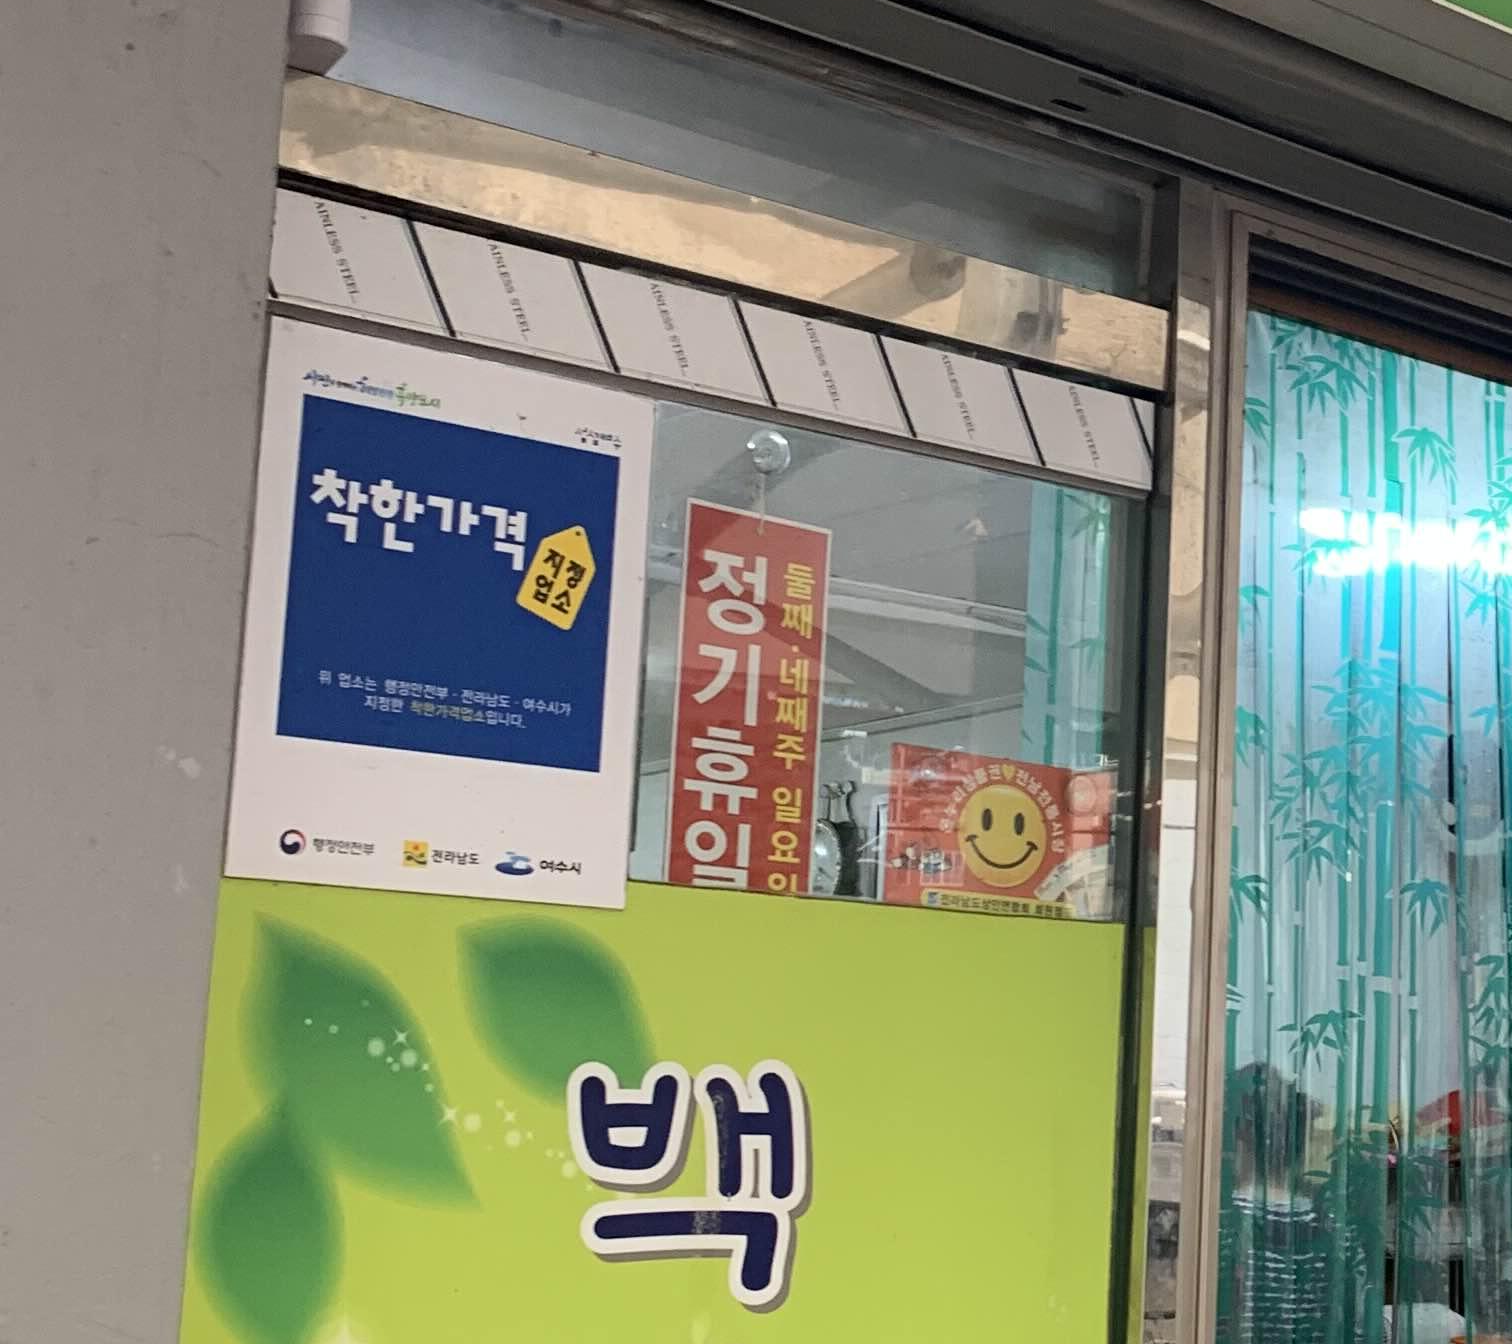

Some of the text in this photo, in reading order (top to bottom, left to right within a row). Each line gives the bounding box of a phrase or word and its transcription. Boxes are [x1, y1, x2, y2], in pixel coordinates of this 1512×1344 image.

[310, 468, 528, 571] 착한가격
[543, 549, 586, 589] 지정
[532, 574, 573, 614] 업소
[337, 671, 377, 692] 업소는
[384, 678, 449, 701] 행정안전부
[461, 688, 511, 709] 전라남도
[522, 697, 572, 717] 여수시가
[683, 548, 769, 890] 정기휴일
[431, 848, 480, 866] 전라남도
[539, 858, 582, 876] 여수시
